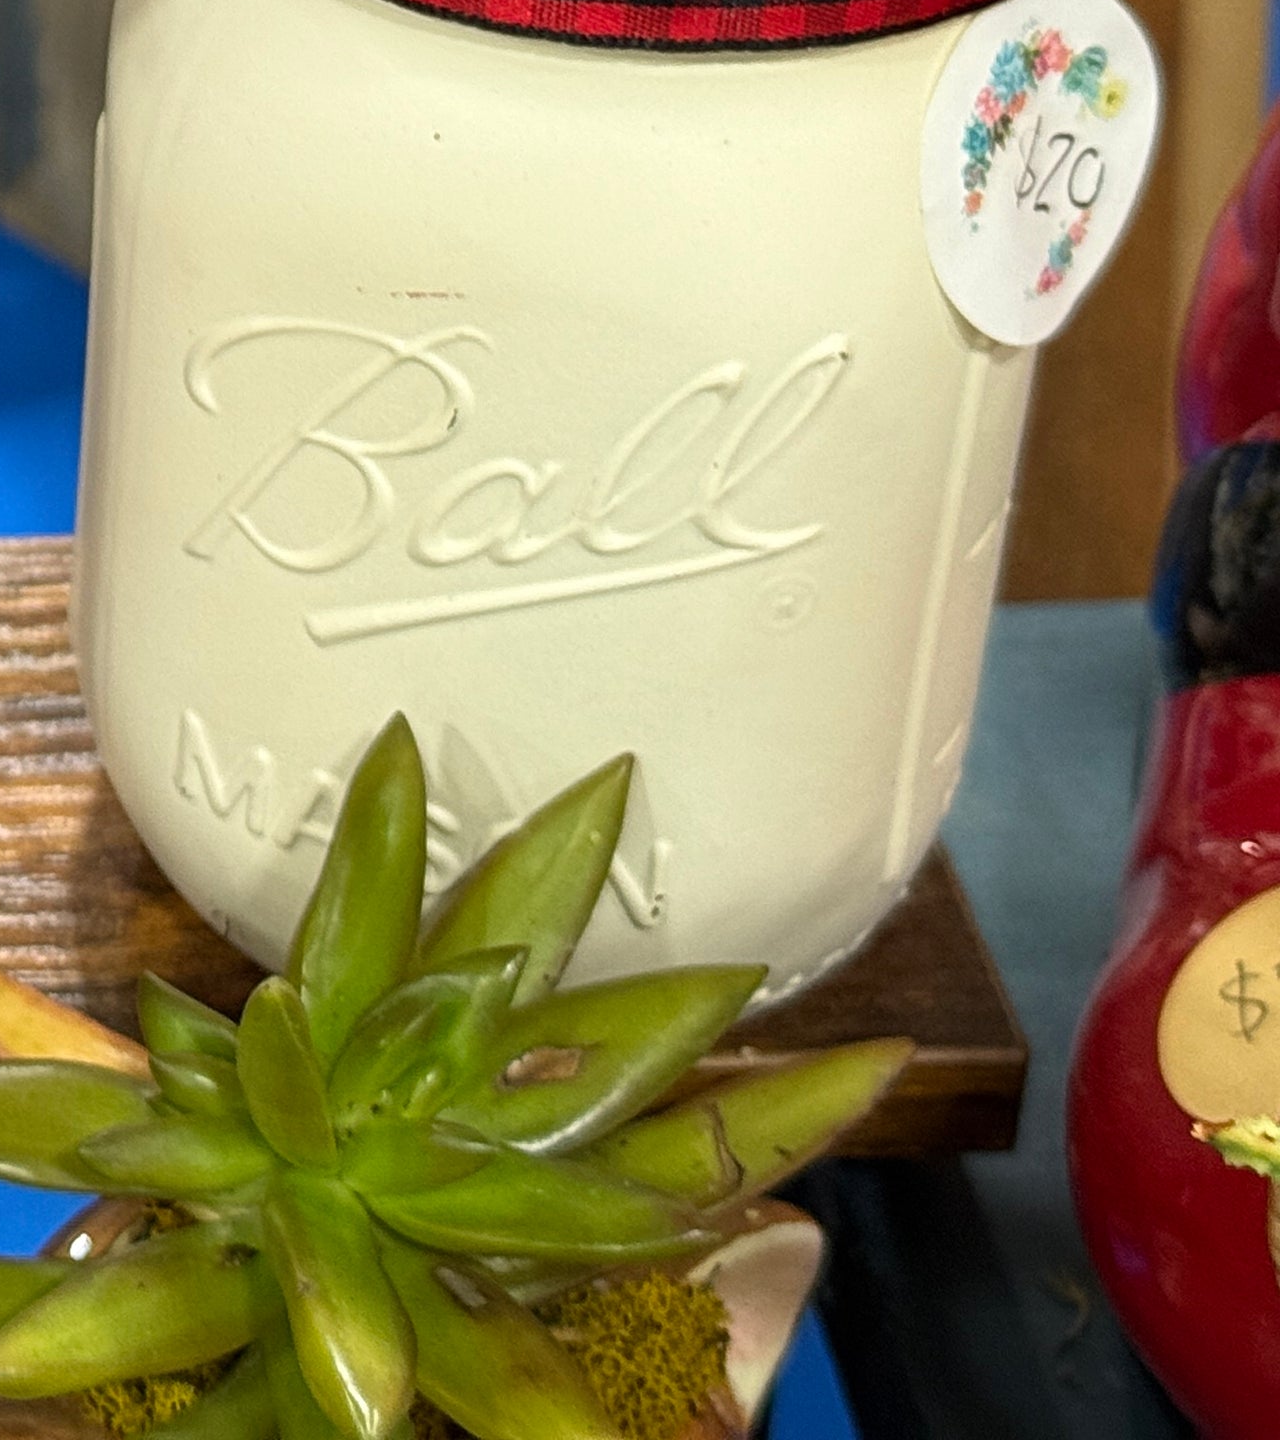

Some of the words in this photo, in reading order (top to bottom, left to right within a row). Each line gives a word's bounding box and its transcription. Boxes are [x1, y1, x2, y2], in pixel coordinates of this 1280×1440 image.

[1013, 115, 1106, 213] $20
[184, 314, 852, 574] Ball
[173, 707, 674, 928] MAN
